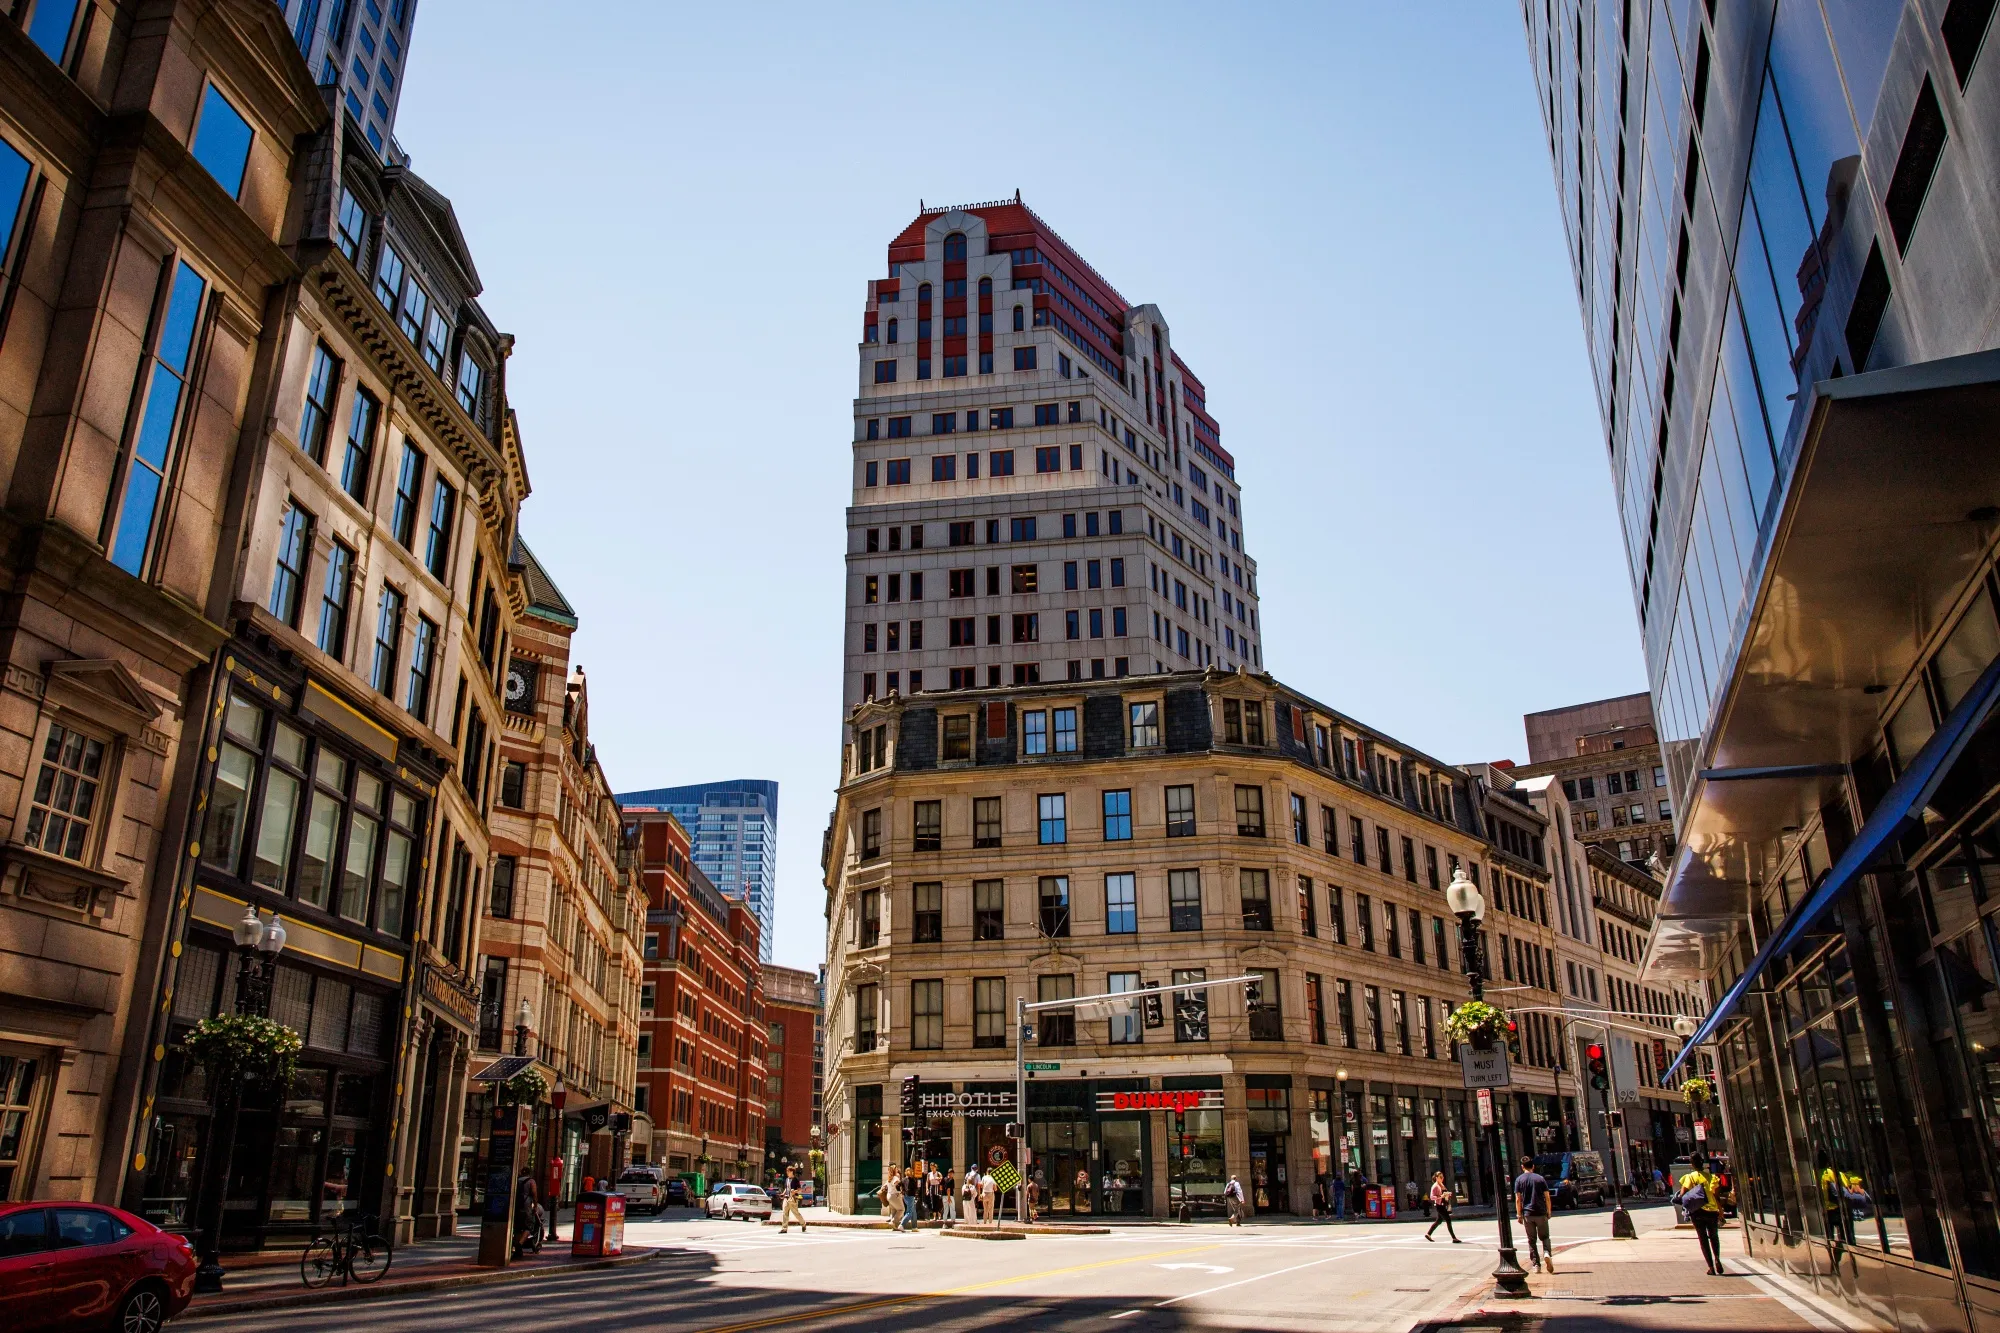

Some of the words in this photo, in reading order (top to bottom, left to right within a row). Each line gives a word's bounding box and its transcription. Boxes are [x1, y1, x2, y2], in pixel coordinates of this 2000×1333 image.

[427, 970, 460, 1012] STARBUCKS
[459, 995, 477, 1024] COFFEE
[1473, 1060, 1494, 1070] MUST
[1470, 1075, 1486, 1083] TURN
[1487, 1074, 1502, 1082] LEFT
[922, 1092, 1011, 1107] HIPOTLE
[1619, 1090, 1637, 1102] 99
[926, 1110, 965, 1118] EXICAN
[969, 1109, 999, 1117] GRILL
[591, 1114, 605, 1125] 99
